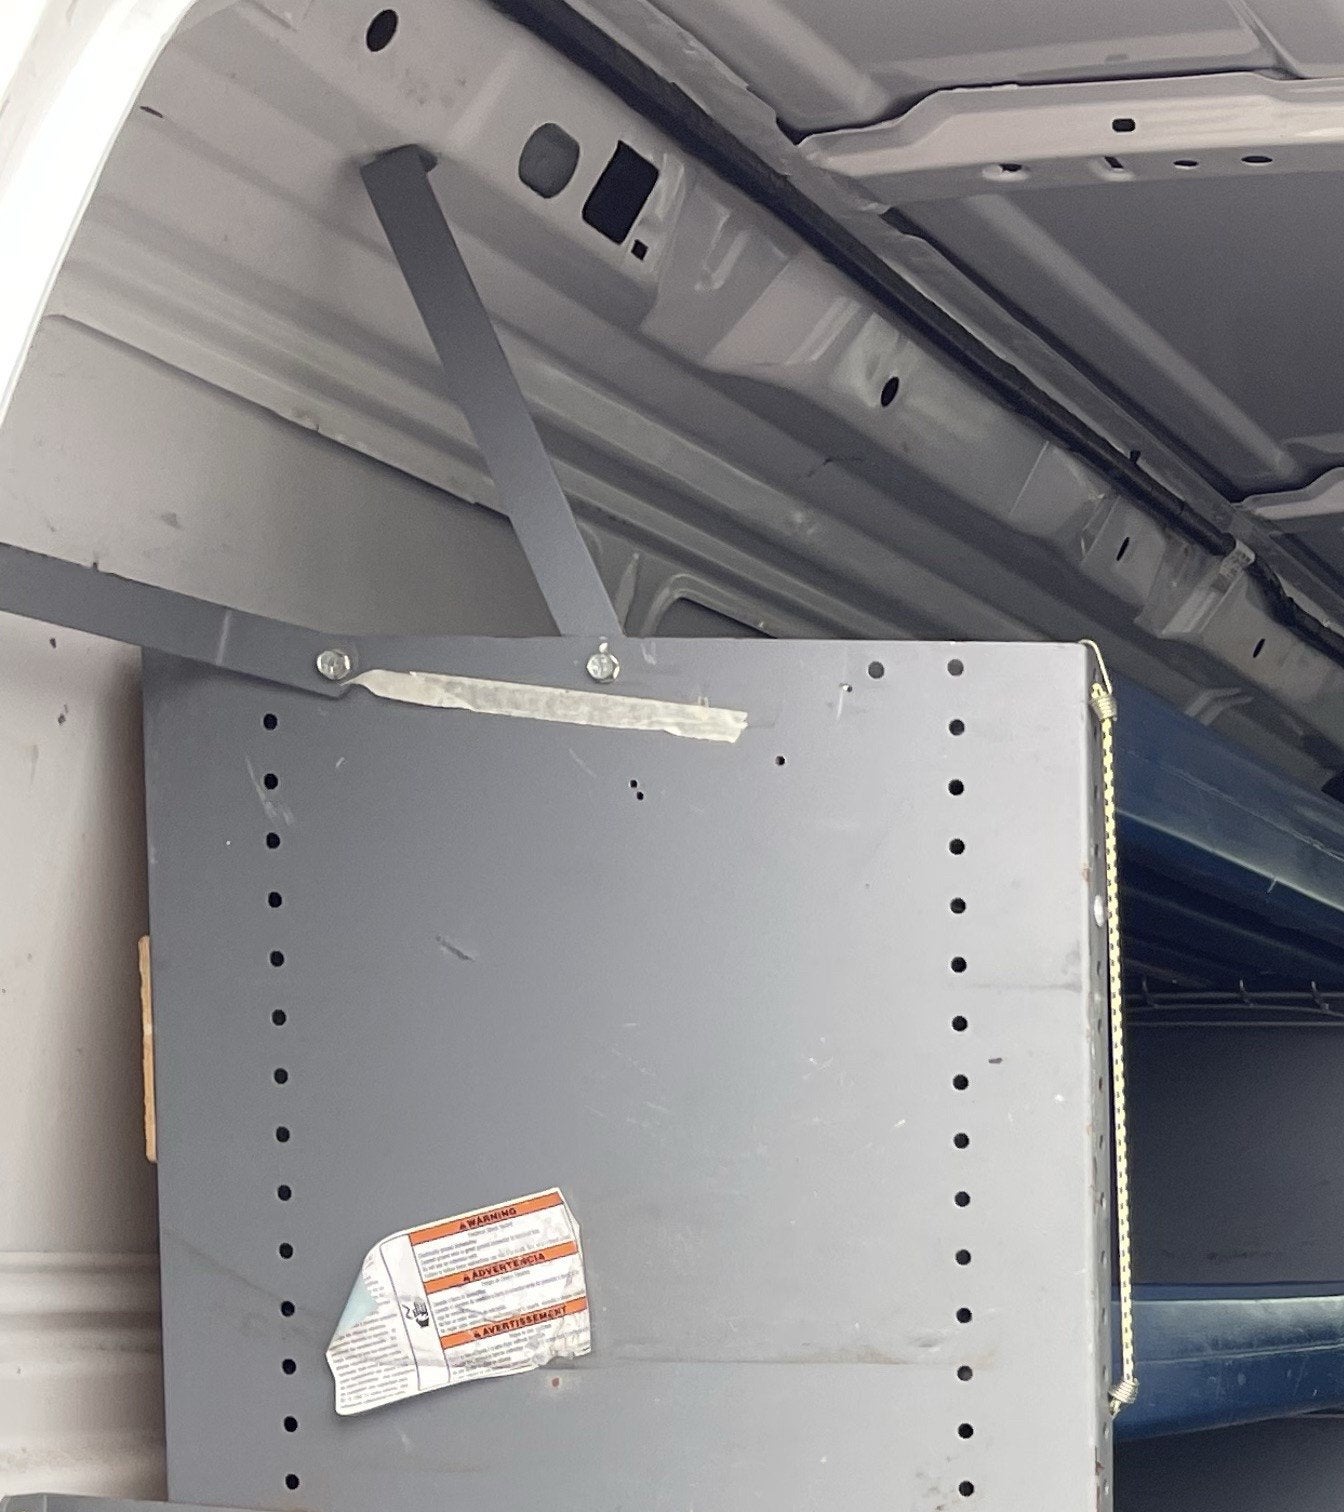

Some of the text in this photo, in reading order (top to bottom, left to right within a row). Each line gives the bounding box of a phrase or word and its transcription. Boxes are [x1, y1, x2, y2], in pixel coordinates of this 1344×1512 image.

[467, 1207, 517, 1227] WARNING
[472, 1252, 546, 1279] ADVERTENCIA
[482, 1305, 567, 1337] AVERTISSEMENT
